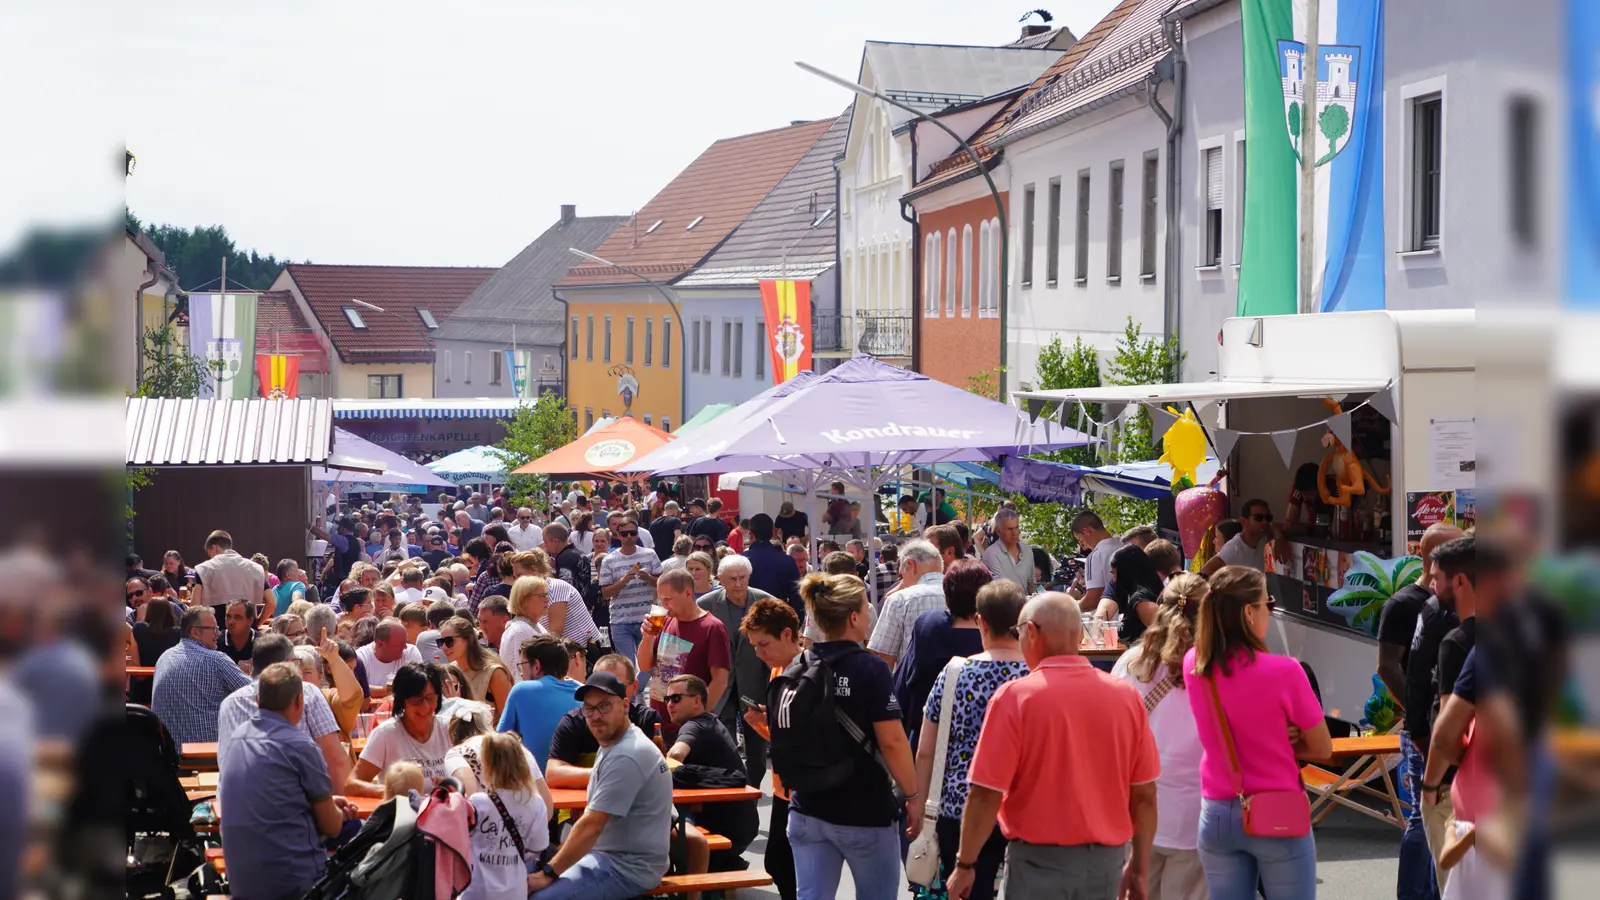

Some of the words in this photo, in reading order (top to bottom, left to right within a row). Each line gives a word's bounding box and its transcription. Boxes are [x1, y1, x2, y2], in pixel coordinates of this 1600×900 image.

[366, 431, 481, 442] TRACHTENKAPELLE
[820, 422, 980, 443] Kondrauer
[453, 471, 492, 482] Kondrauer
[1411, 503, 1450, 518] Abend
[424, 589, 433, 598] P
[838, 676, 849, 687] ER
